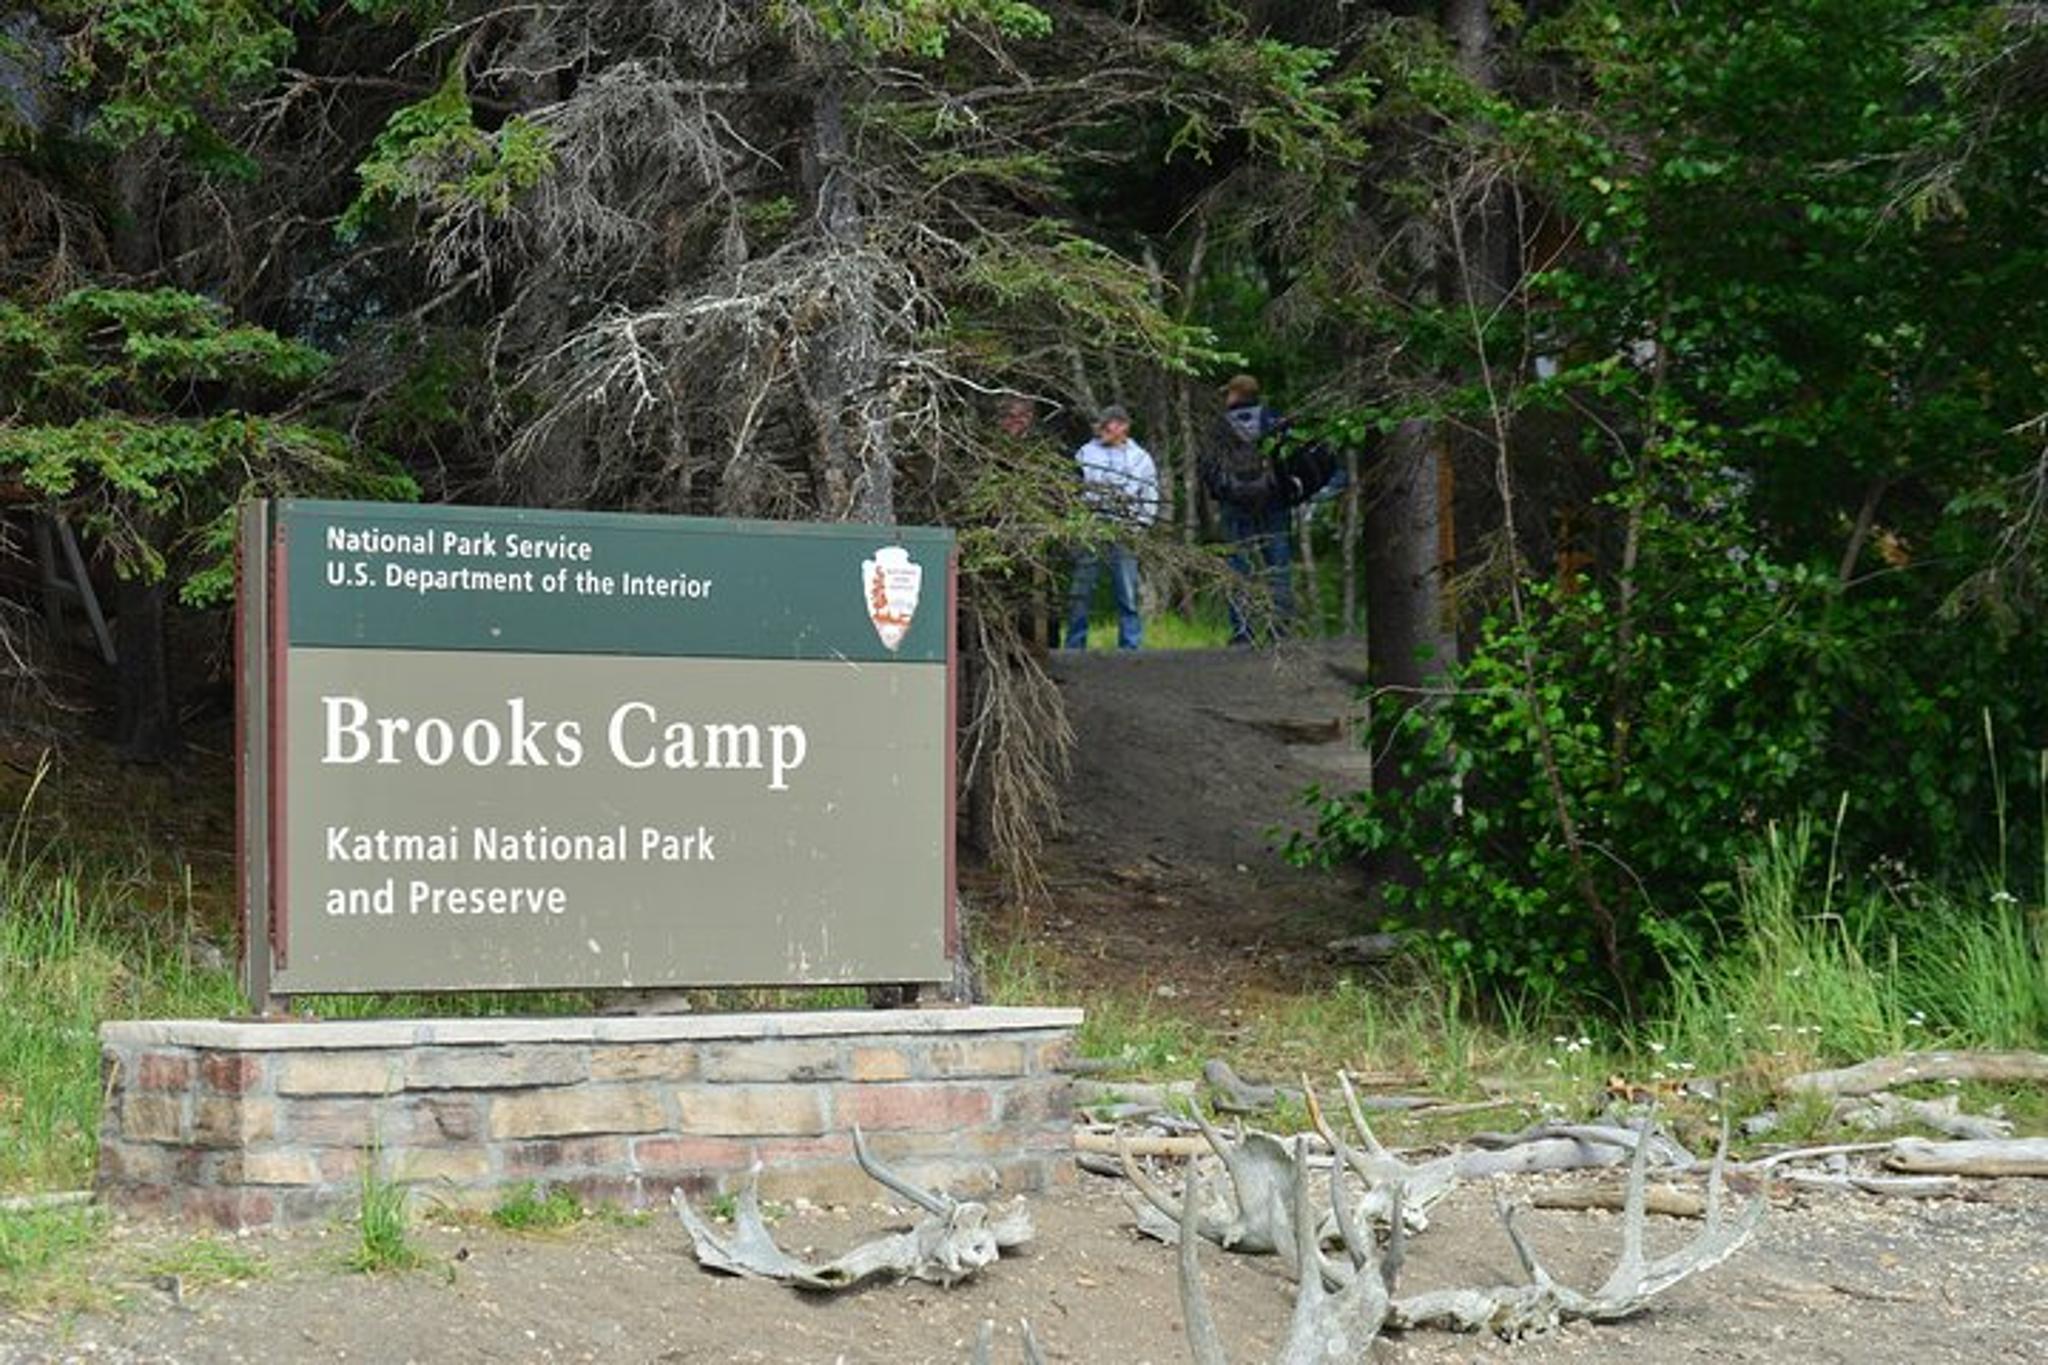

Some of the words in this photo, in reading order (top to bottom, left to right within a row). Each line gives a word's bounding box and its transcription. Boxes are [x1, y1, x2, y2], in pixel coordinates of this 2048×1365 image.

[326, 526, 434, 555] National
[443, 530, 497, 557] Park
[505, 533, 593, 562] Service
[326, 561, 377, 587] U.S.
[385, 562, 534, 594] Department
[541, 568, 567, 593] of
[575, 570, 615, 596] the
[622, 572, 713, 598] Interior
[321, 696, 583, 769] Brooks
[608, 701, 807, 790] Camp
[326, 826, 459, 863] Katmai
[474, 825, 627, 863] National
[641, 826, 716, 862] Park
[326, 878, 394, 915] and
[409, 881, 568, 915] Preserve
